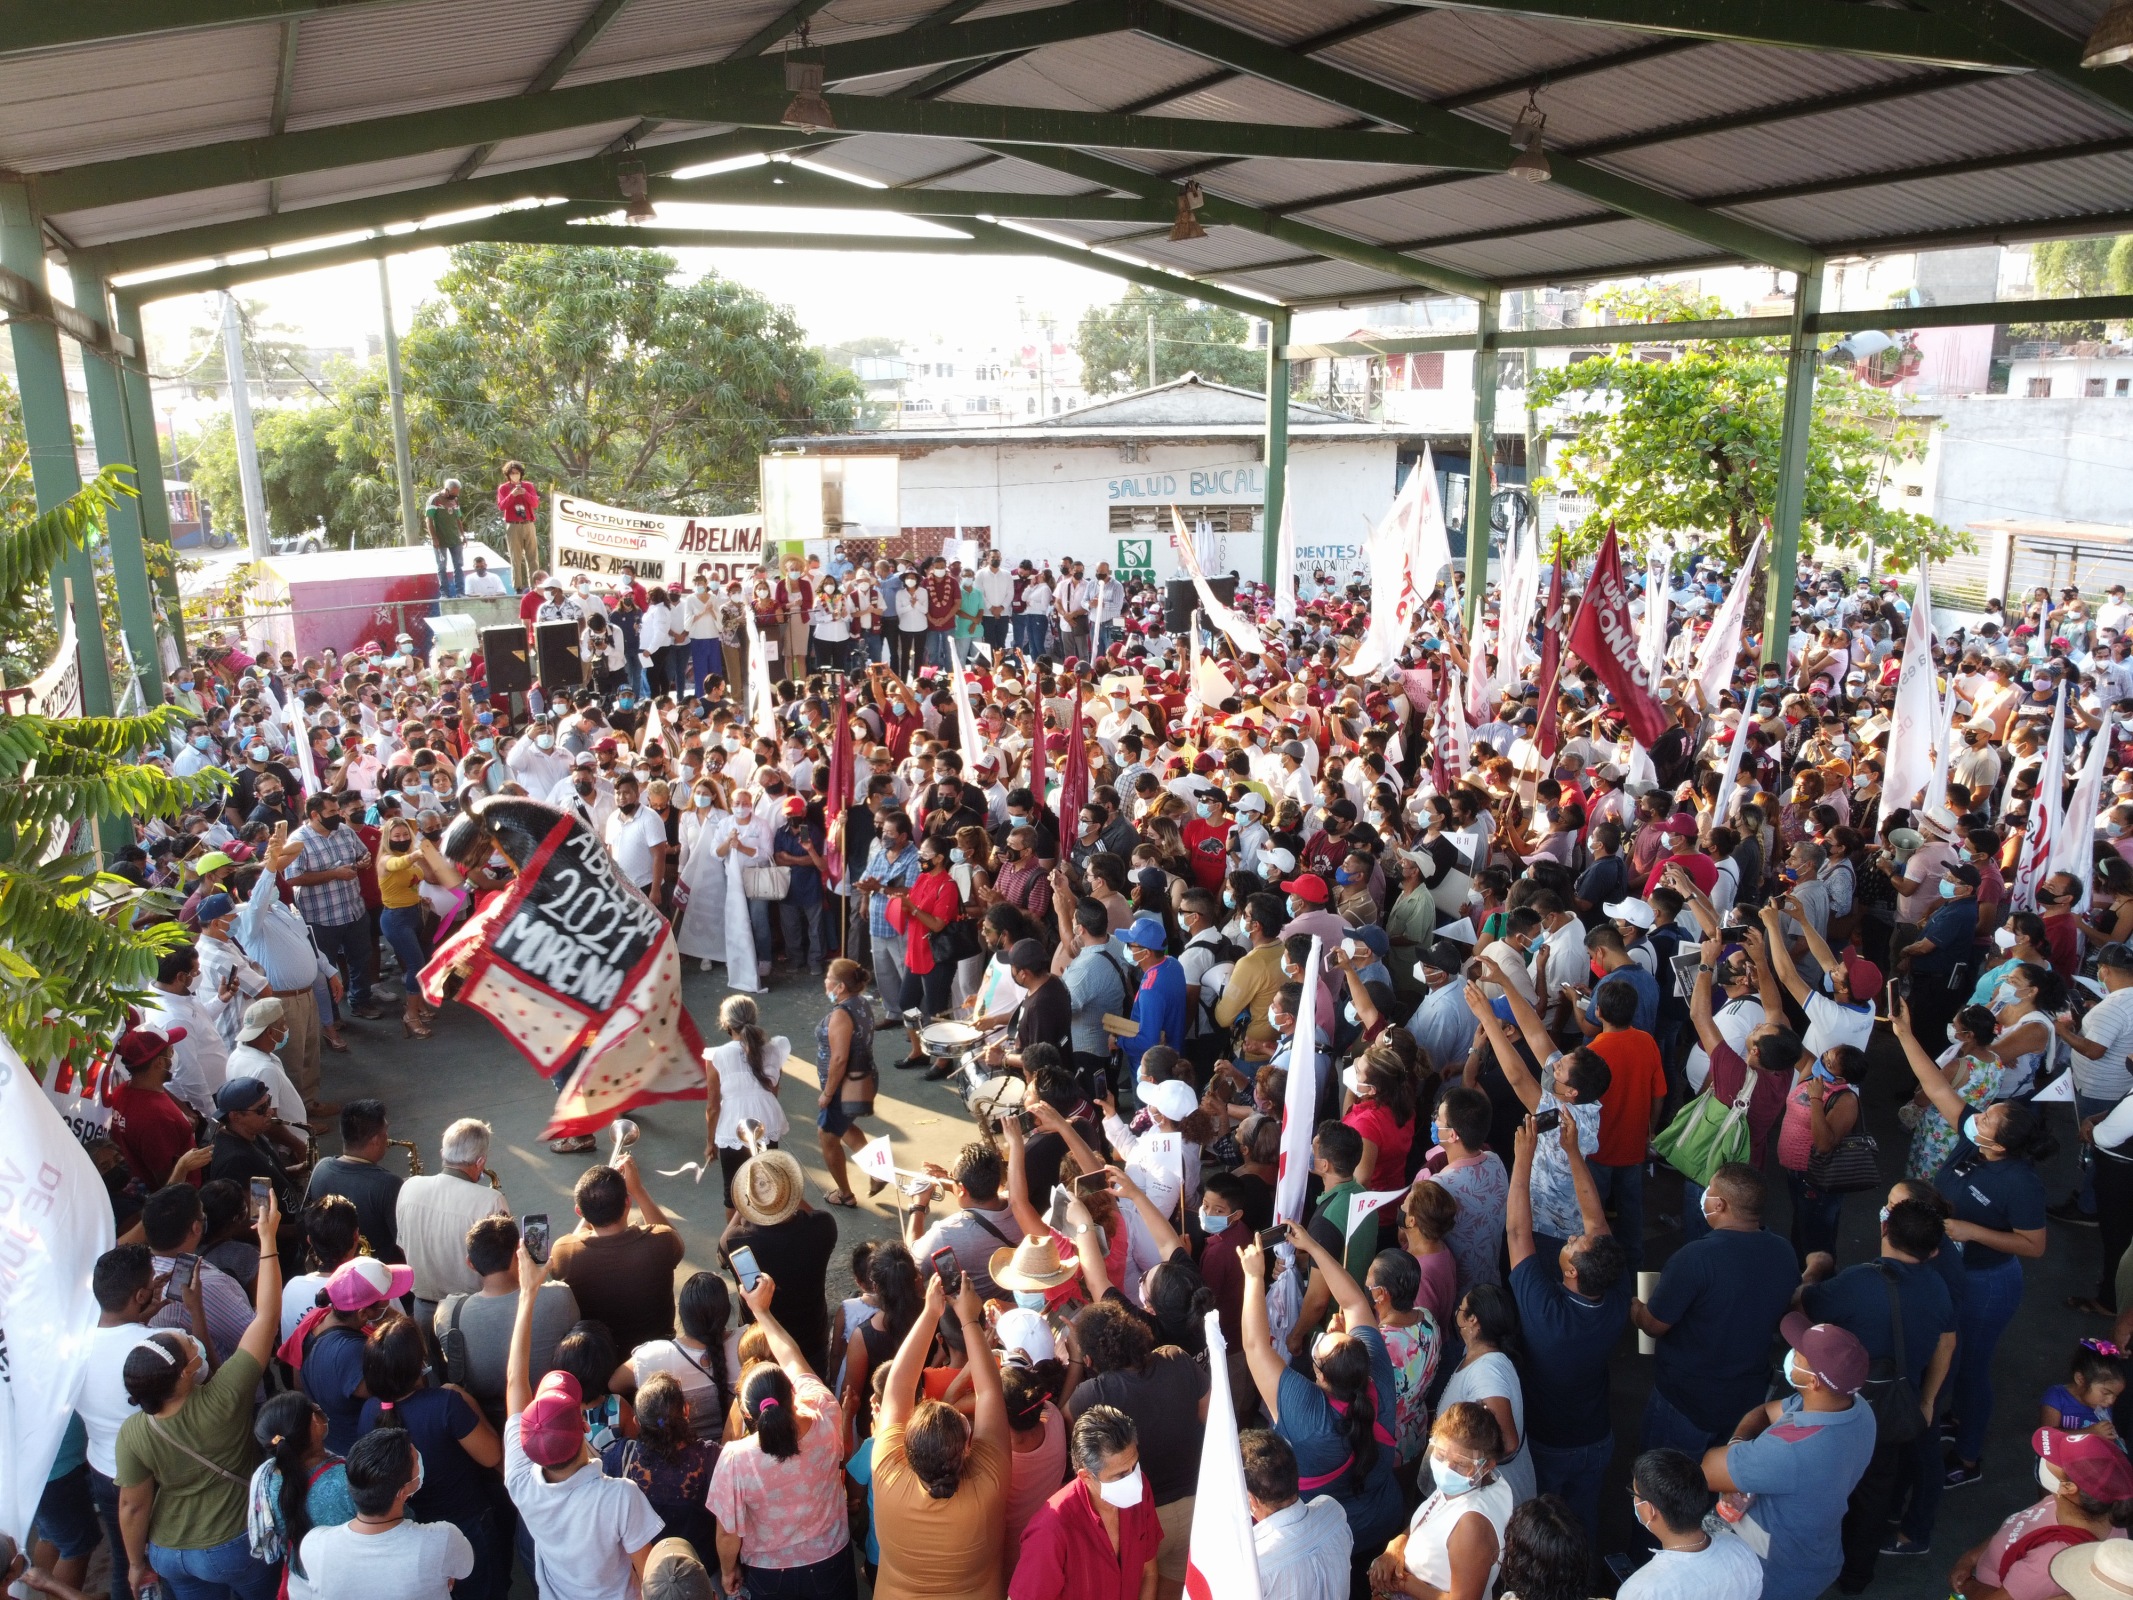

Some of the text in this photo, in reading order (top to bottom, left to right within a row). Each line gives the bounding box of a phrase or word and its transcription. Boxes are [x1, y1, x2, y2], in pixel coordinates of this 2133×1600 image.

[1109, 469, 1263, 499] SALUD BUCAL
[559, 499, 665, 529] CONSTRUYENDO
[679, 520, 762, 552] ABELINA
[559, 548, 601, 571] ISAIAS
[1600, 571, 1627, 611] LUIS
[1586, 583, 1649, 687] MONRO
[538, 868, 638, 964] 2021
[495, 913, 625, 1008] MORENA
[2041, 1430, 2051, 1456] morena
